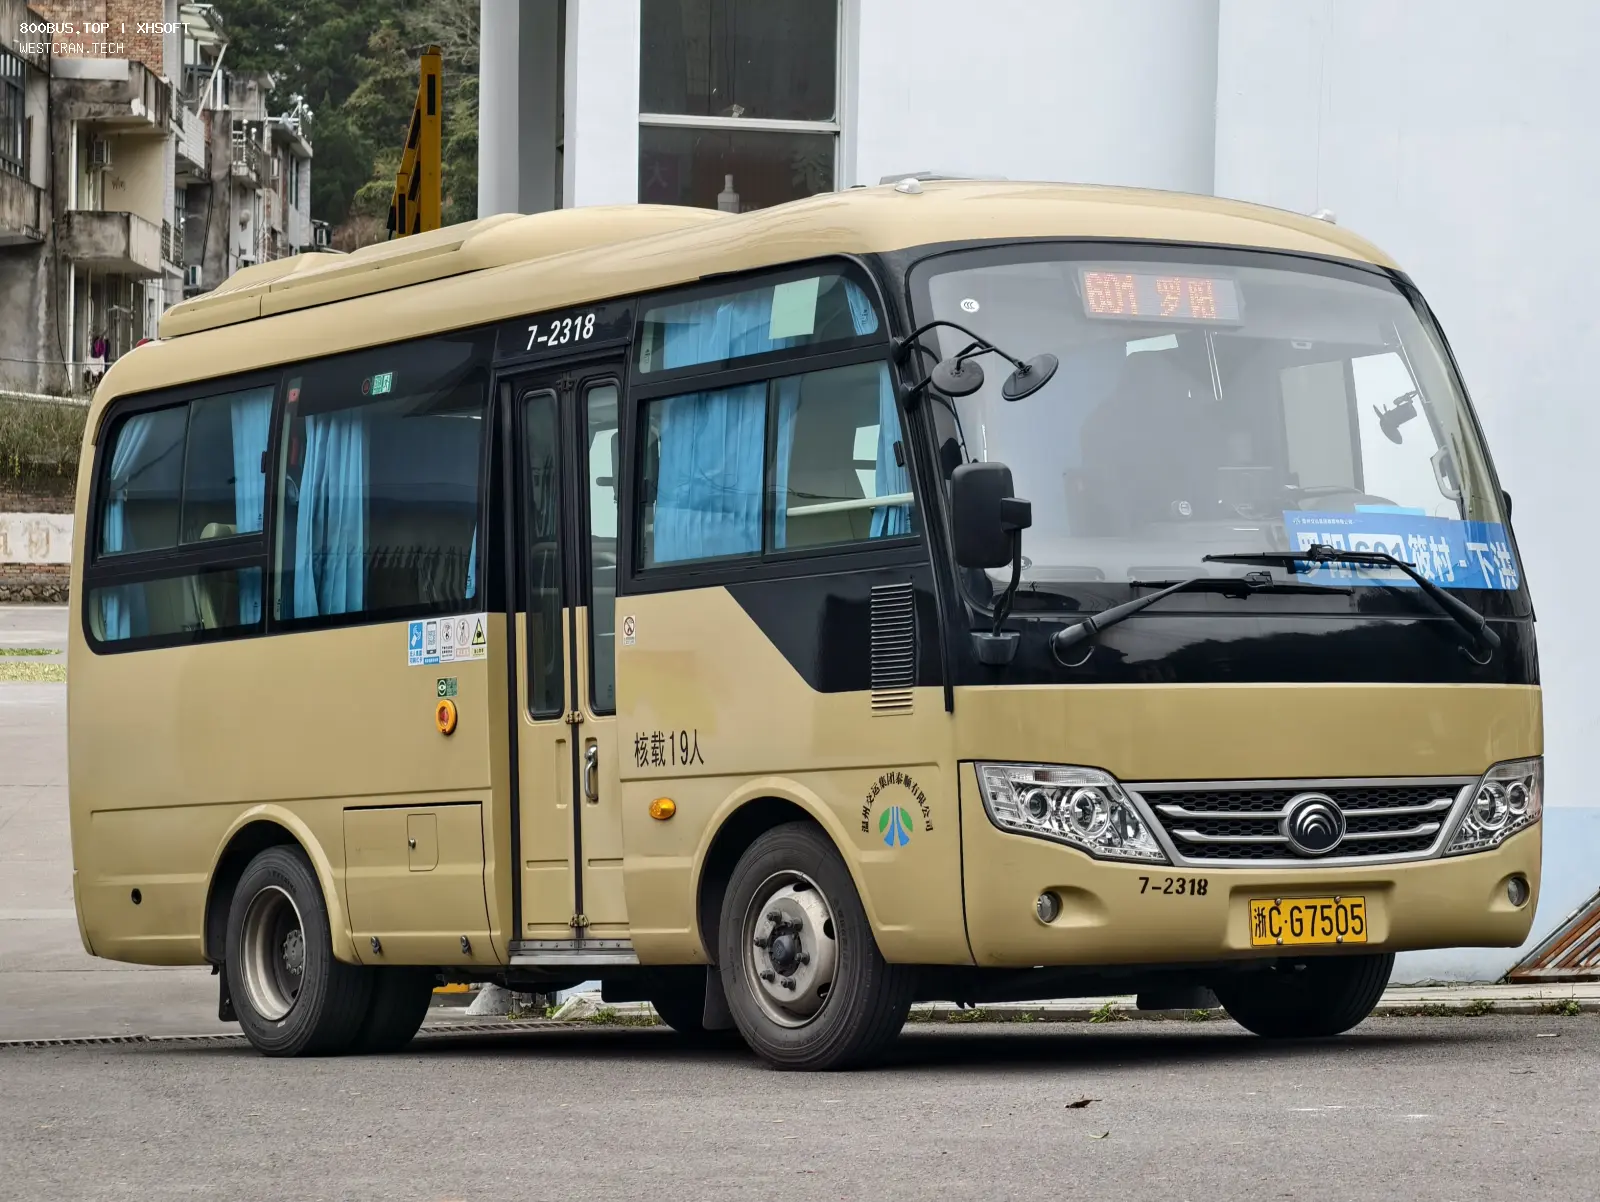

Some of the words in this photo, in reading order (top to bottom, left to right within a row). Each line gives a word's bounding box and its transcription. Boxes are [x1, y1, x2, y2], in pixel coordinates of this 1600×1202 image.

[1086, 272, 1138, 315] 601
[526, 313, 596, 351] 7-2318
[634, 728, 704, 768] 核载19人
[861, 771, 934, 833] 温州交运集团泰顺有限公司
[1138, 876, 1209, 896] 7-2318
